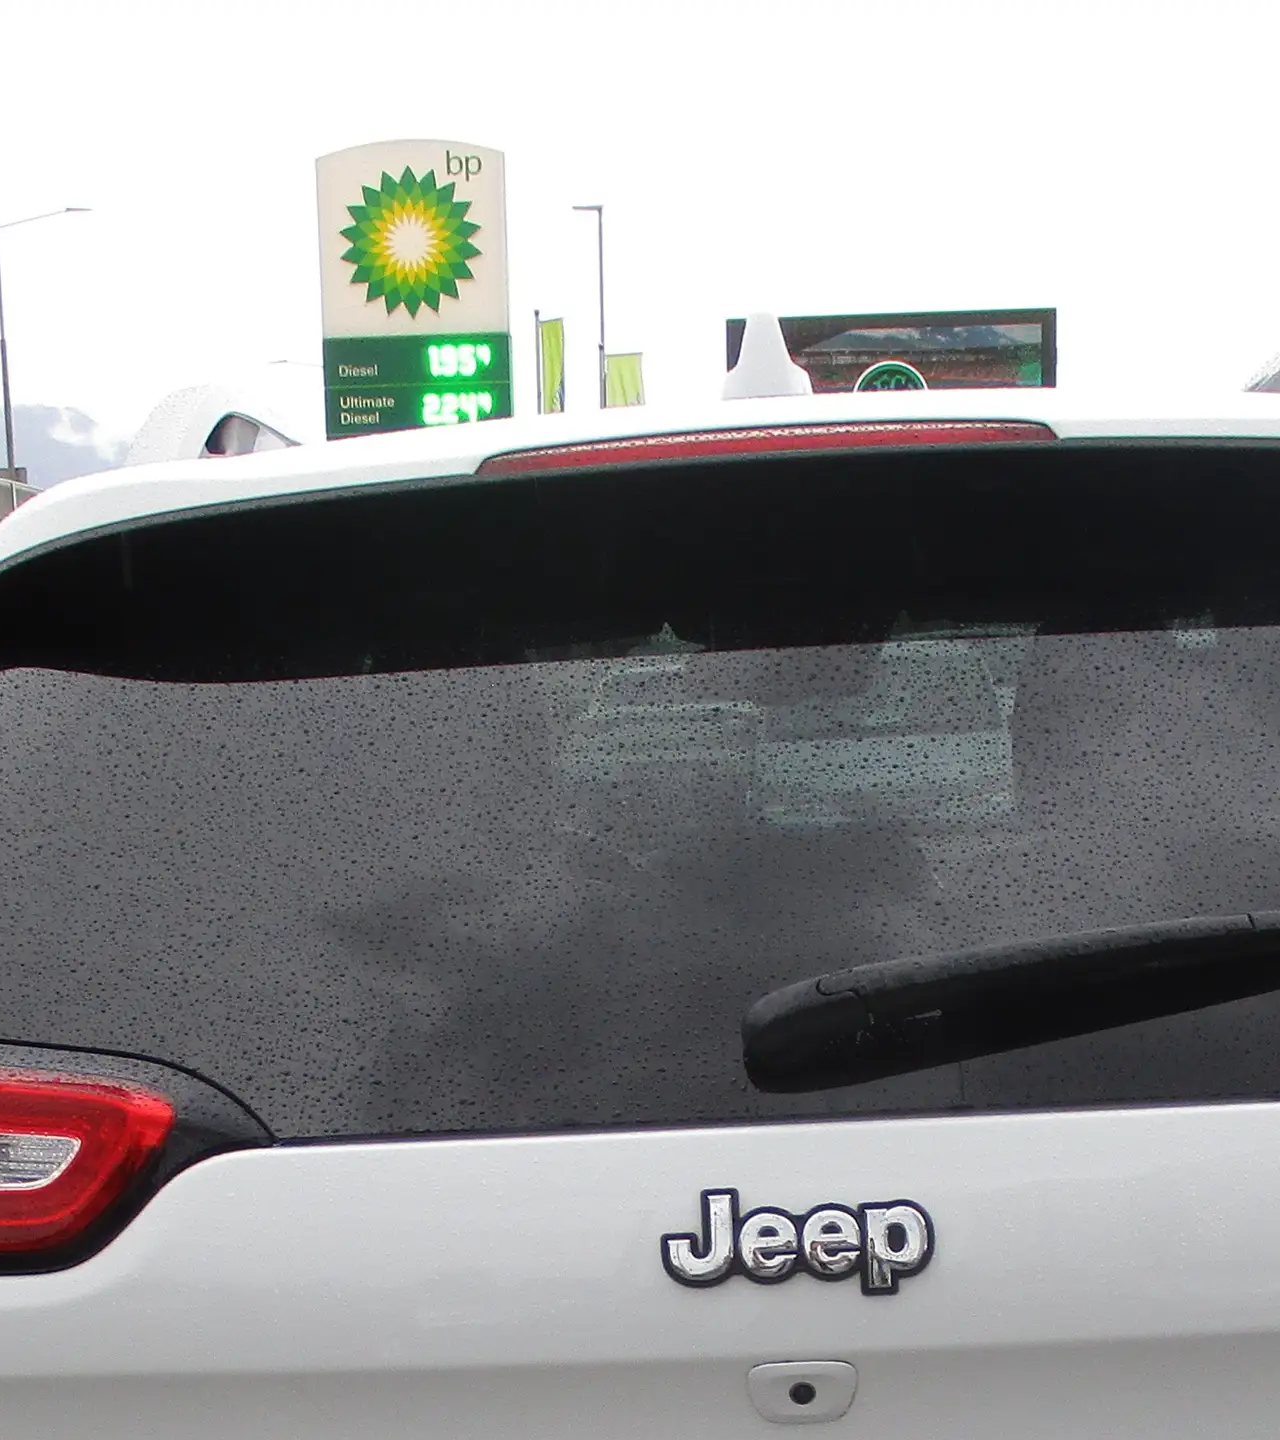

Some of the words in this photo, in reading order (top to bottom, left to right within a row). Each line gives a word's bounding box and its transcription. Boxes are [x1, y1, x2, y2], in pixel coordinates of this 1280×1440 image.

[445, 150, 482, 181] bp
[338, 364, 379, 378] Diesel
[339, 396, 395, 410] Ultimate
[340, 411, 380, 426] Diesel
[661, 1187, 935, 1296] Jeep
